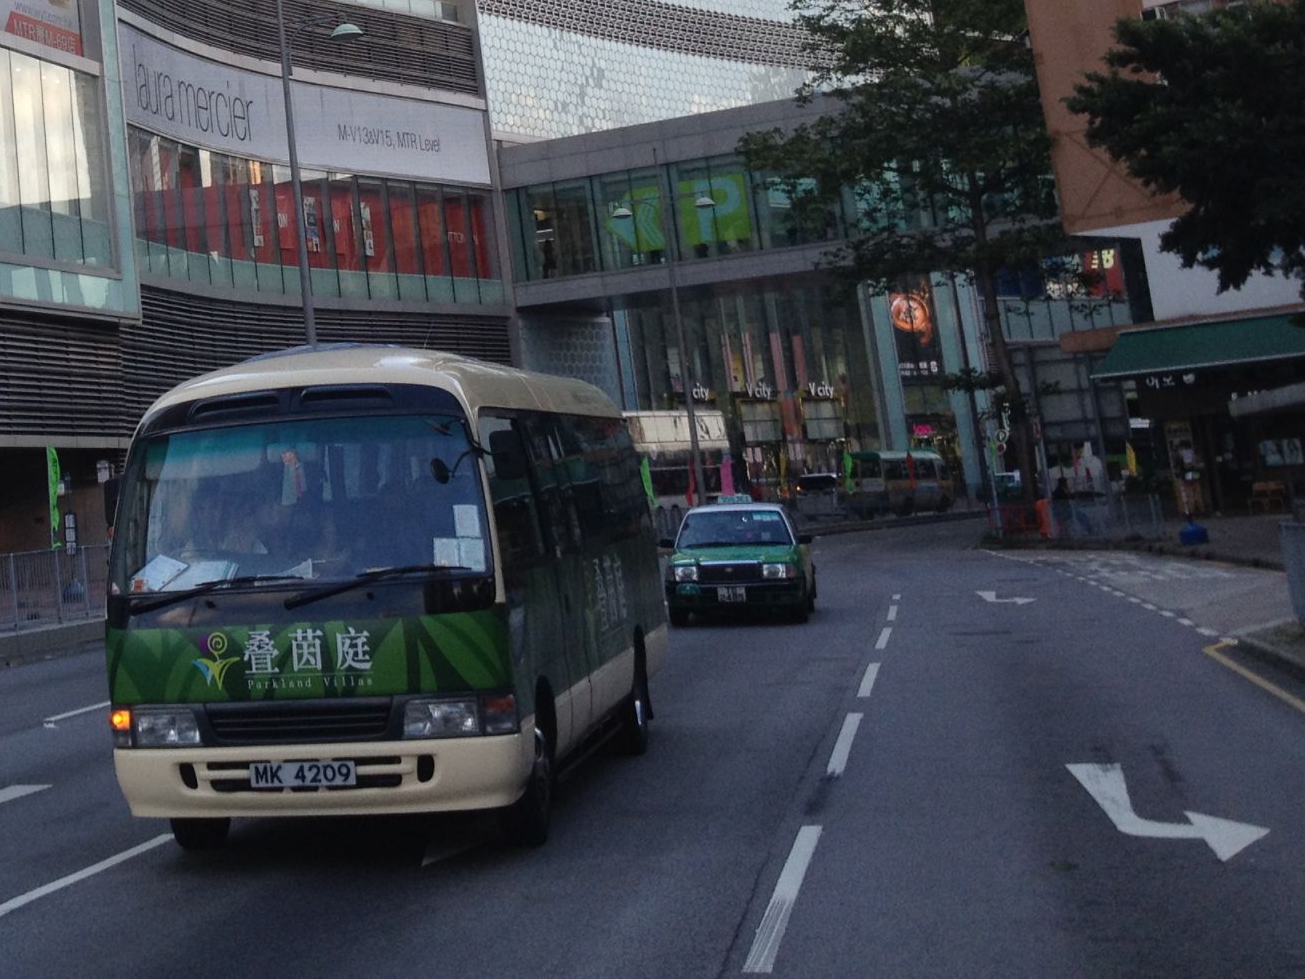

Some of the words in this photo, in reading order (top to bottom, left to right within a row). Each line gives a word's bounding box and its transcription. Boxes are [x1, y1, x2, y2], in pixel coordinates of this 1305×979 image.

[132, 45, 174, 122] laura
[177, 80, 253, 142] mercier
[397, 131, 417, 150] MTR
[419, 134, 440, 153] Level
[746, 383, 754, 398] V
[754, 382, 771, 399] city
[808, 382, 817, 397] V
[817, 381, 834, 398] city
[243, 627, 374, 675] 叠茵庭
[247, 677, 312, 690] Parkland
[323, 675, 374, 688] Villas
[254, 763, 283, 785] MK
[294, 761, 351, 783] 4209
